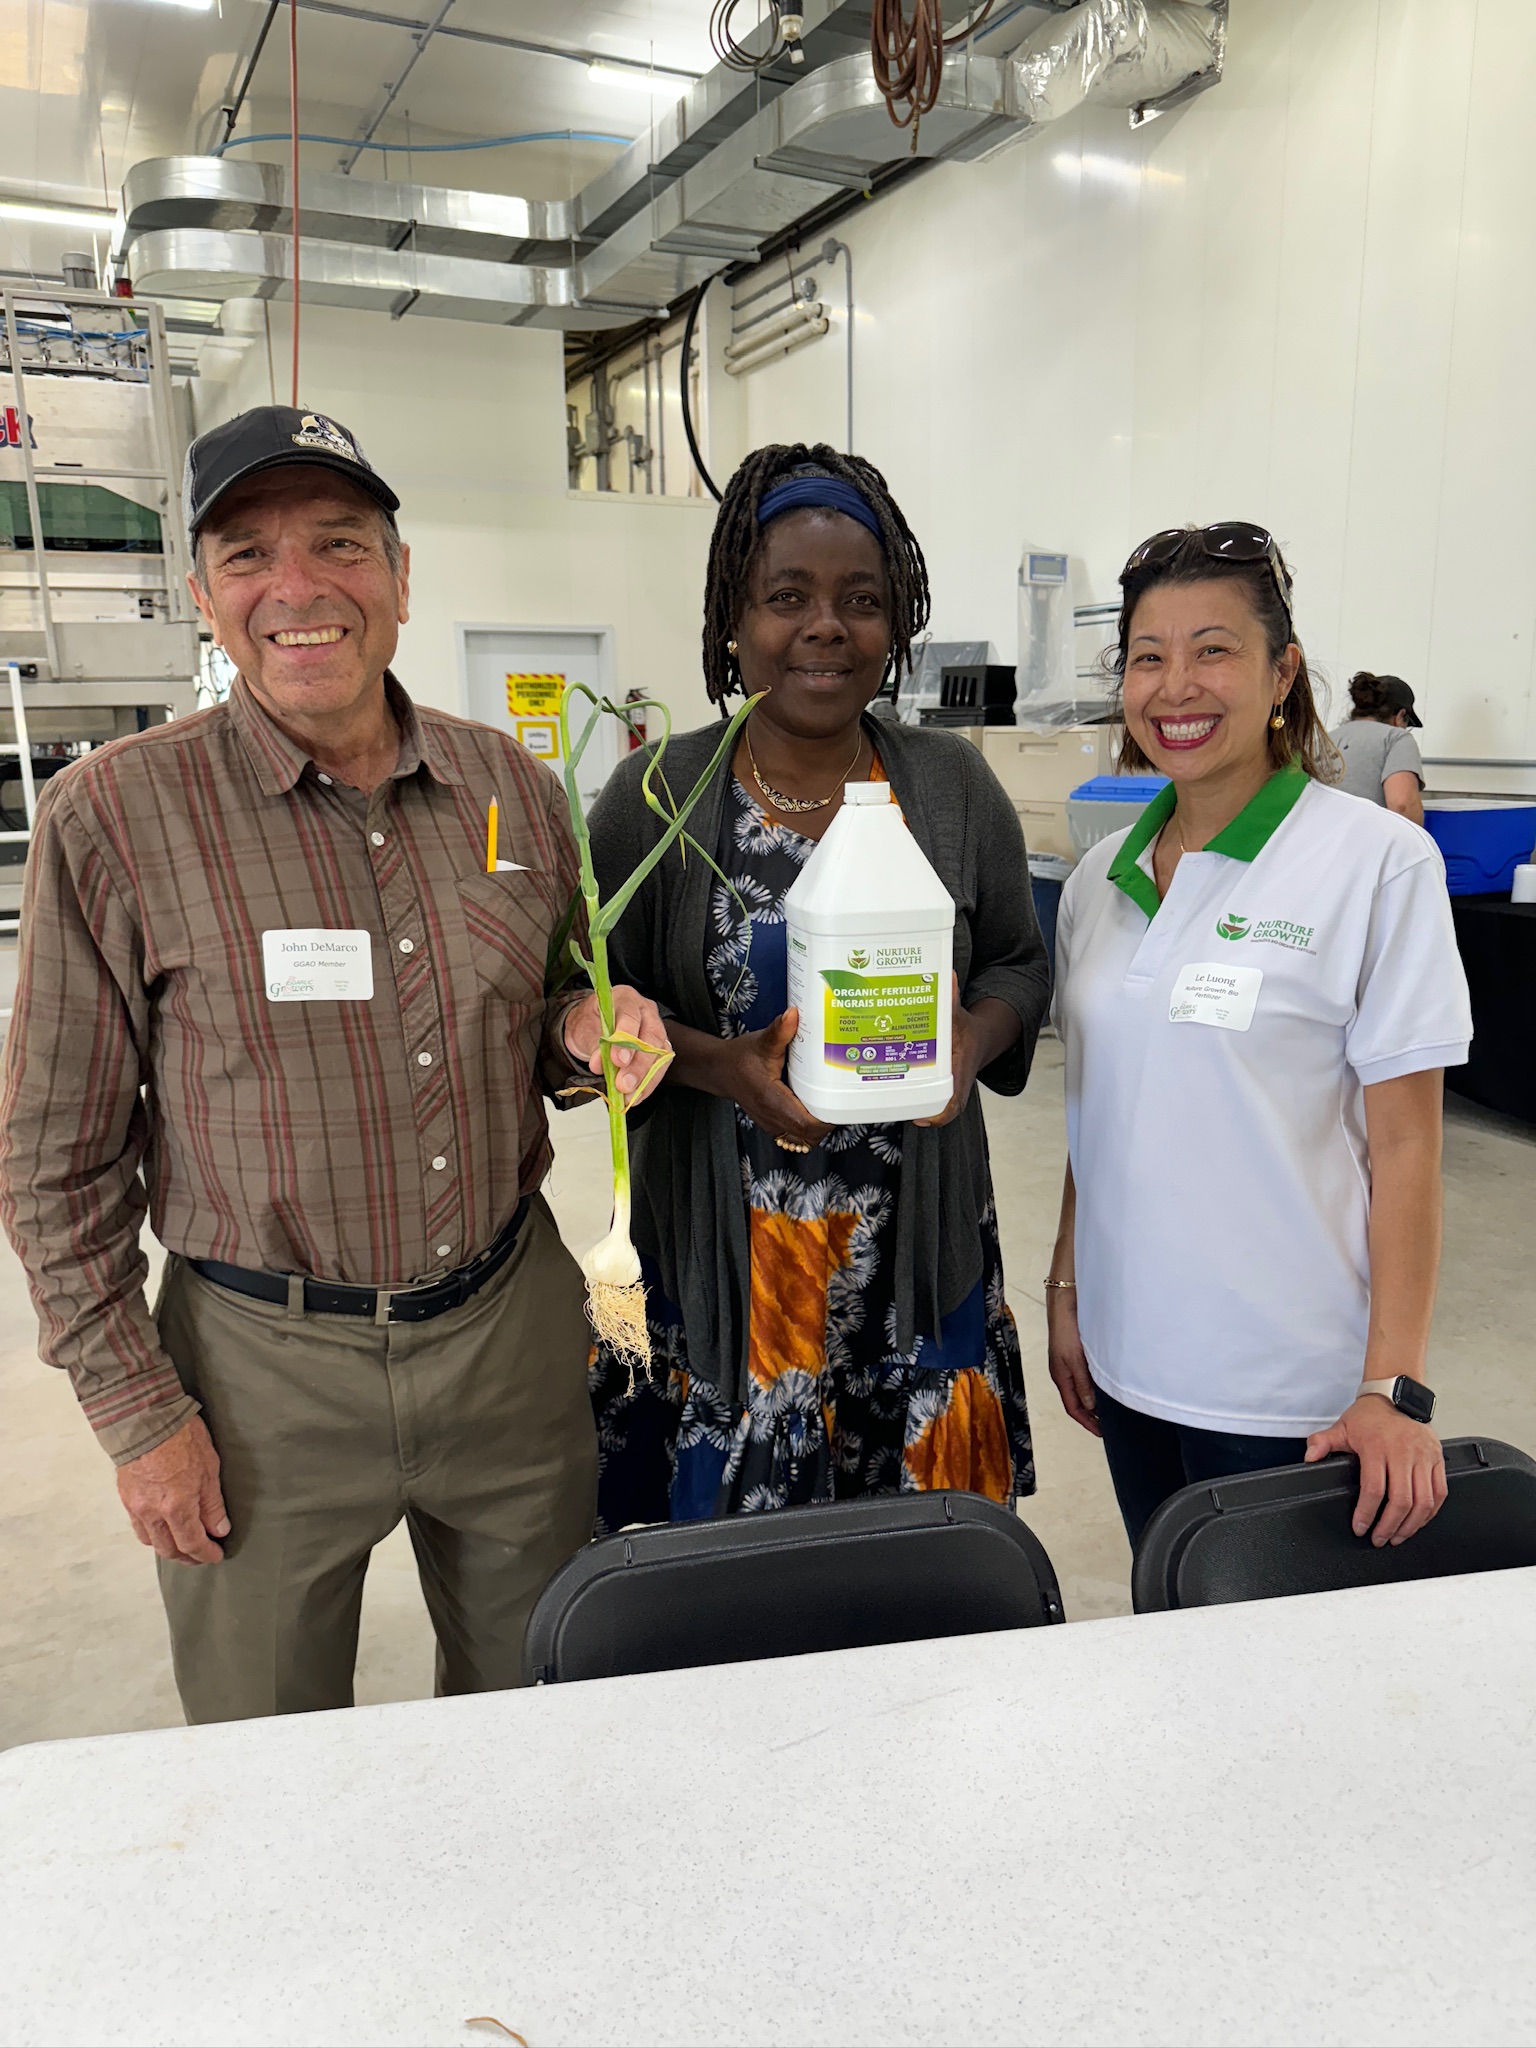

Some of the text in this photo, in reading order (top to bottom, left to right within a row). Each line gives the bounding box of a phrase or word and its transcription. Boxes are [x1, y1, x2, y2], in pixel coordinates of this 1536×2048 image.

[515, 682, 558, 690] AUTHORIZED
[516, 691, 556, 699] PERSONNEL
[1256, 919, 1315, 937] NURTURE
[1253, 929, 1310, 947] GROWTH
[281, 942, 358, 952] John DeMarco
[876, 947, 922, 957] NURTURE
[293, 960, 316, 968] GGAO
[876, 955, 922, 966] GROWTH
[1195, 974, 1237, 987] Le Luong
[833, 985, 932, 997] ORGANIC FERTILIZER
[1194, 992, 1222, 1000] Fertilizer
[1203, 986, 1227, 994] Growth
[1227, 989, 1239, 997] Bio
[831, 995, 935, 1008] ENGRAIS BIOLOGIQUE
[906, 1015, 930, 1023] DÉCHETS
[891, 1022, 930, 1031] ALIMENTAIRES
